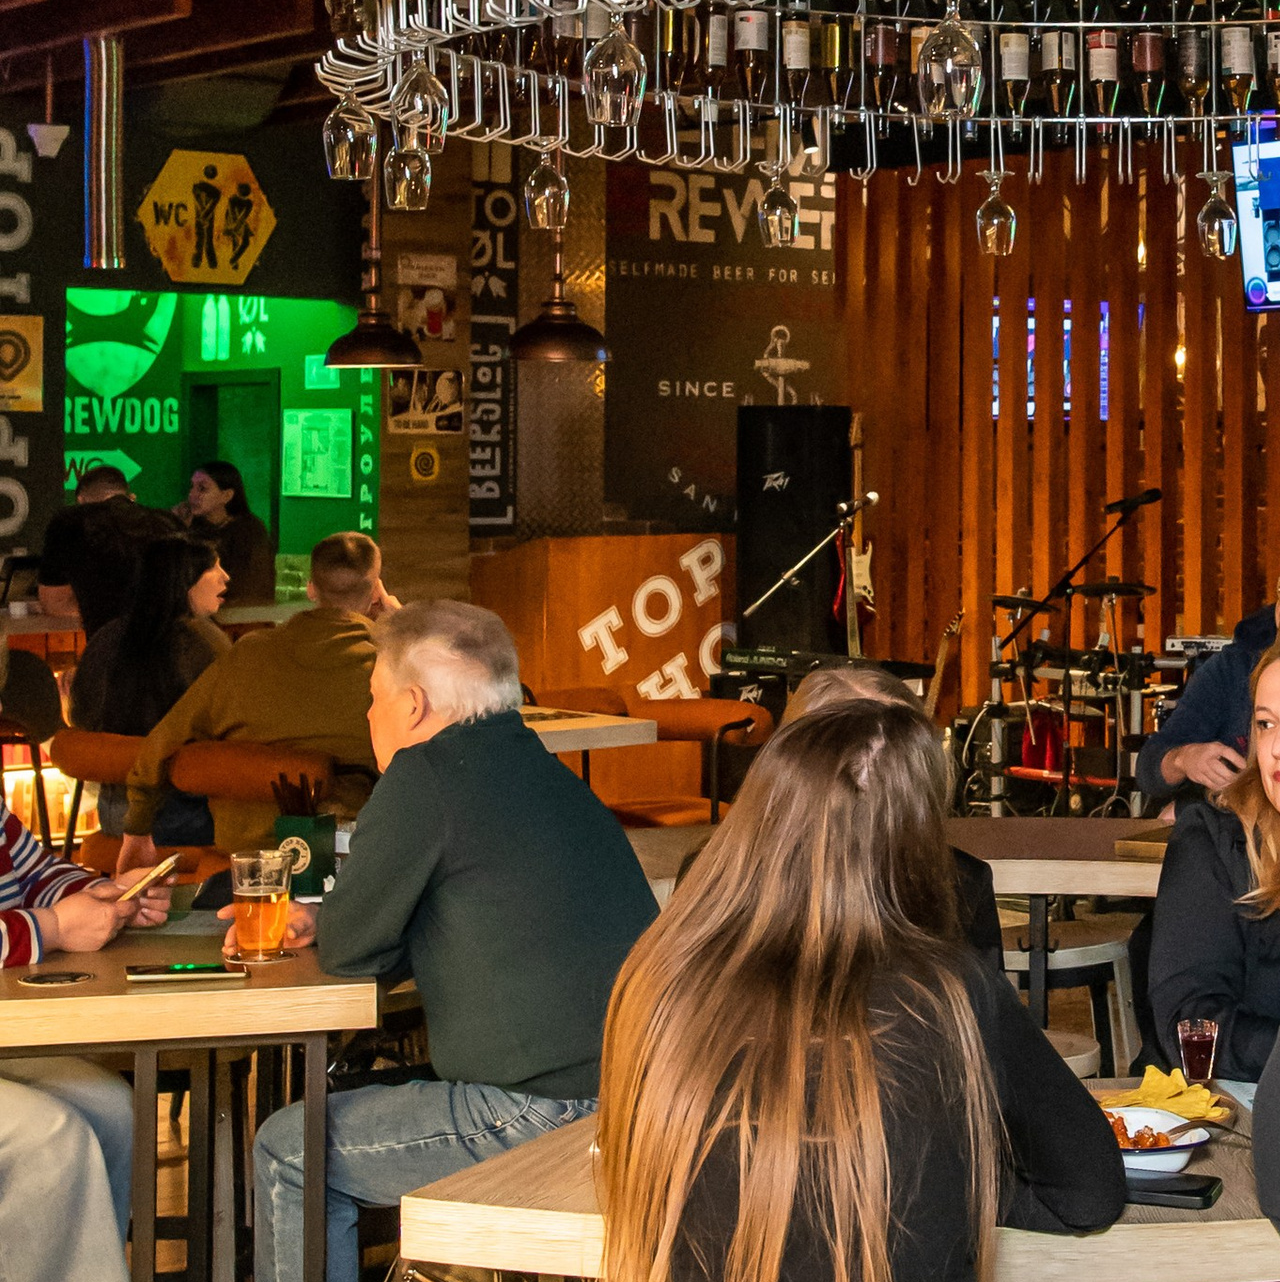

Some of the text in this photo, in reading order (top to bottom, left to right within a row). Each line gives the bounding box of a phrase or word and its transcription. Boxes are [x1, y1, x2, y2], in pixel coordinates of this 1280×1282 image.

[152, 200, 189, 228] WC
[713, 265, 755, 281] BEER
[768, 267, 798, 283] FOR
[657, 379, 735, 398] SINCE
[359, 367, 374, 531] ГРОУЛЕ
[577, 537, 726, 676] TOP
